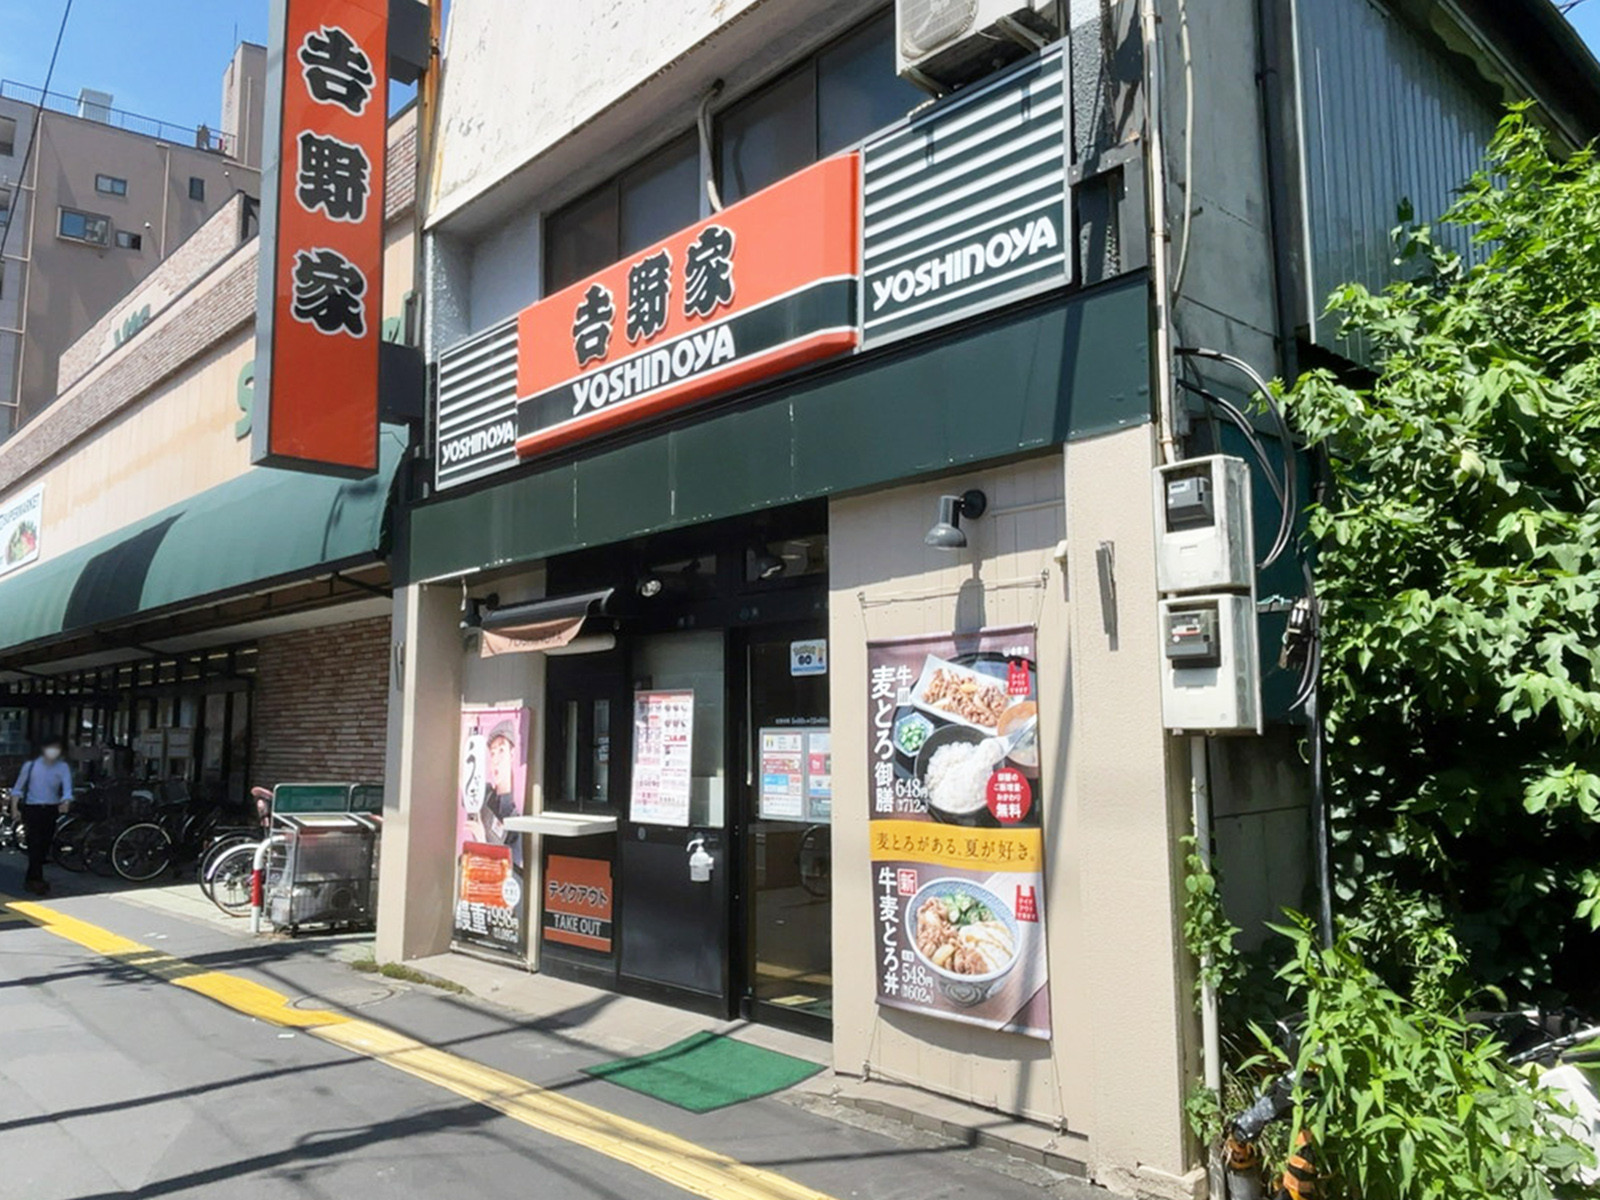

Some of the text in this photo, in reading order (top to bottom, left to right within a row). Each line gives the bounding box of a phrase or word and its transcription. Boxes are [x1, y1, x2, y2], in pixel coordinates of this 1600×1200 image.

[872, 215, 1058, 311] YOSHINOYA
[572, 324, 737, 417] YOSHINOYA
[441, 420, 516, 466] YOSHINOYA
[896, 664, 912, 705] 牛皿
[871, 664, 896, 813] 麦とろ御膳
[996, 802, 1022, 819] 無料
[548, 880, 608, 908] テイクアウト
[901, 873, 915, 892] 新
[554, 914, 602, 936] TAKE OUT
[878, 866, 899, 996] 牛麦とろ丼
